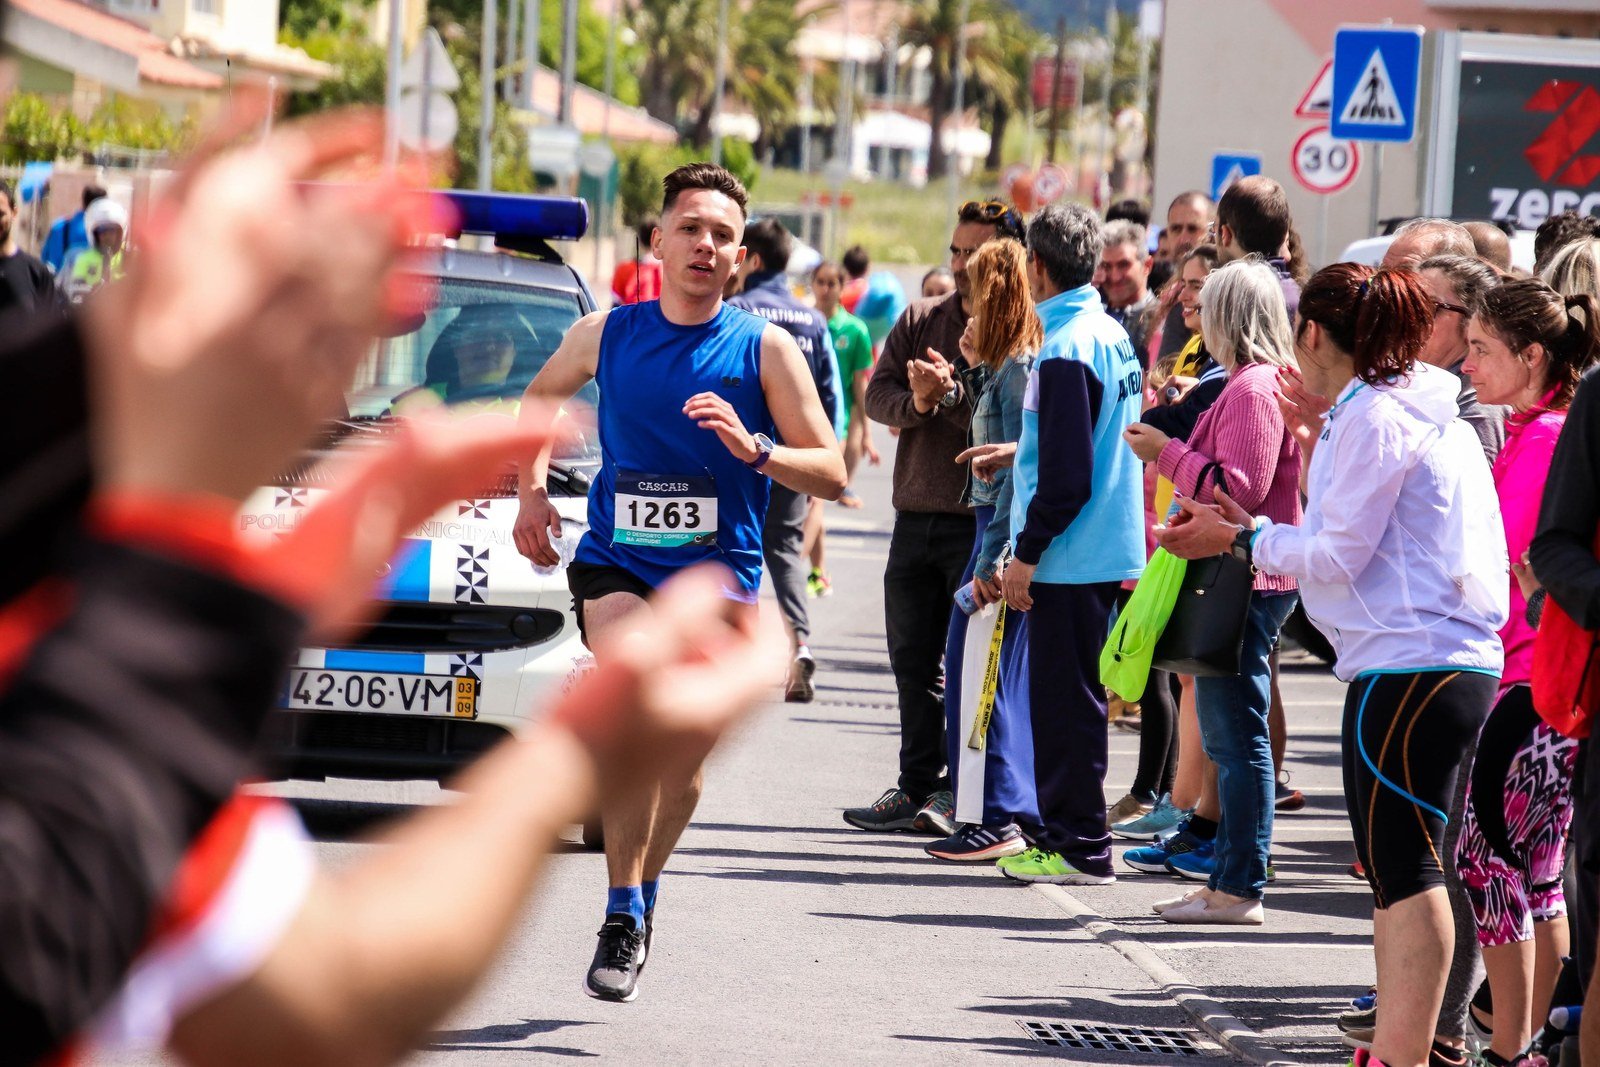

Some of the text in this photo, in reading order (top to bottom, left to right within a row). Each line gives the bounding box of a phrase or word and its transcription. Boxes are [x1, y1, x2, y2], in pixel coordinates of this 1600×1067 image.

[1303, 145, 1348, 172] 30
[638, 481, 689, 492] CASCAIS
[628, 500, 701, 529] 1263
[458, 682, 472, 693] 03
[457, 701, 471, 714] 09
